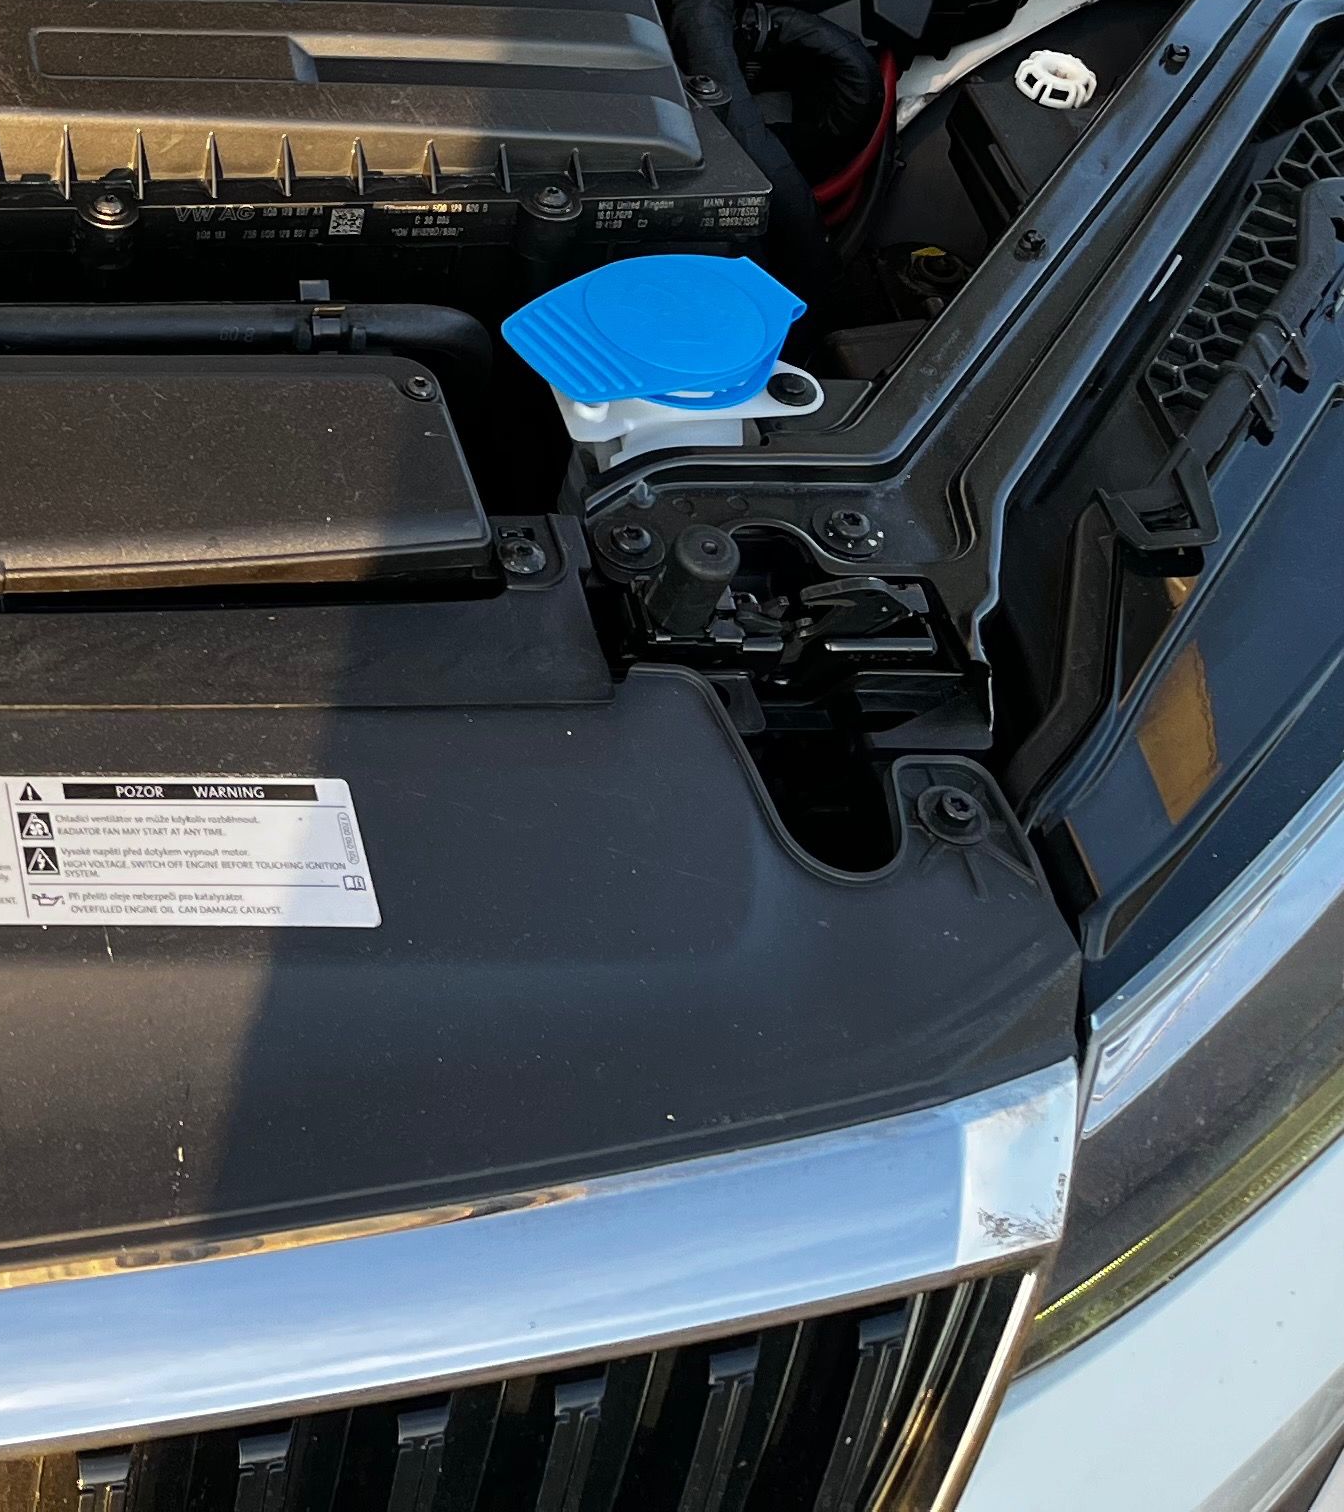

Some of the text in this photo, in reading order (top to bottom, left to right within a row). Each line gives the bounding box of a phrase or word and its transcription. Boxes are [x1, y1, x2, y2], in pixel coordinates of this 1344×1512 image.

[616, 200, 675, 211] United Kingdom
[703, 198, 725, 207] MANN
[175, 206, 215, 222] VW
[218, 204, 256, 221] AG
[115, 786, 265, 799] POZOR WARNING
[57, 828, 100, 836] RADIATOR
[102, 828, 121, 836] FAN
[122, 828, 141, 836] MAY
[143, 828, 169, 836] START
[170, 828, 181, 836] AT
[183, 828, 202, 836] ANY
[131, 861, 166, 869] SWITCH
[167, 861, 183, 869] OFF
[185, 861, 219, 869] ENGINE
[221, 861, 254, 869] BEFORE
[256, 861, 304, 869] TOUCHING
[305, 862, 346, 870] IGNITION
[178, 894, 193, 902] pro
[71, 905, 123, 914] OVERFILLED
[124, 905, 158, 914] ENGINE
[160, 906, 174, 914] OIL
[178, 906, 197, 914] CAN
[199, 906, 239, 914] DAMAGE
